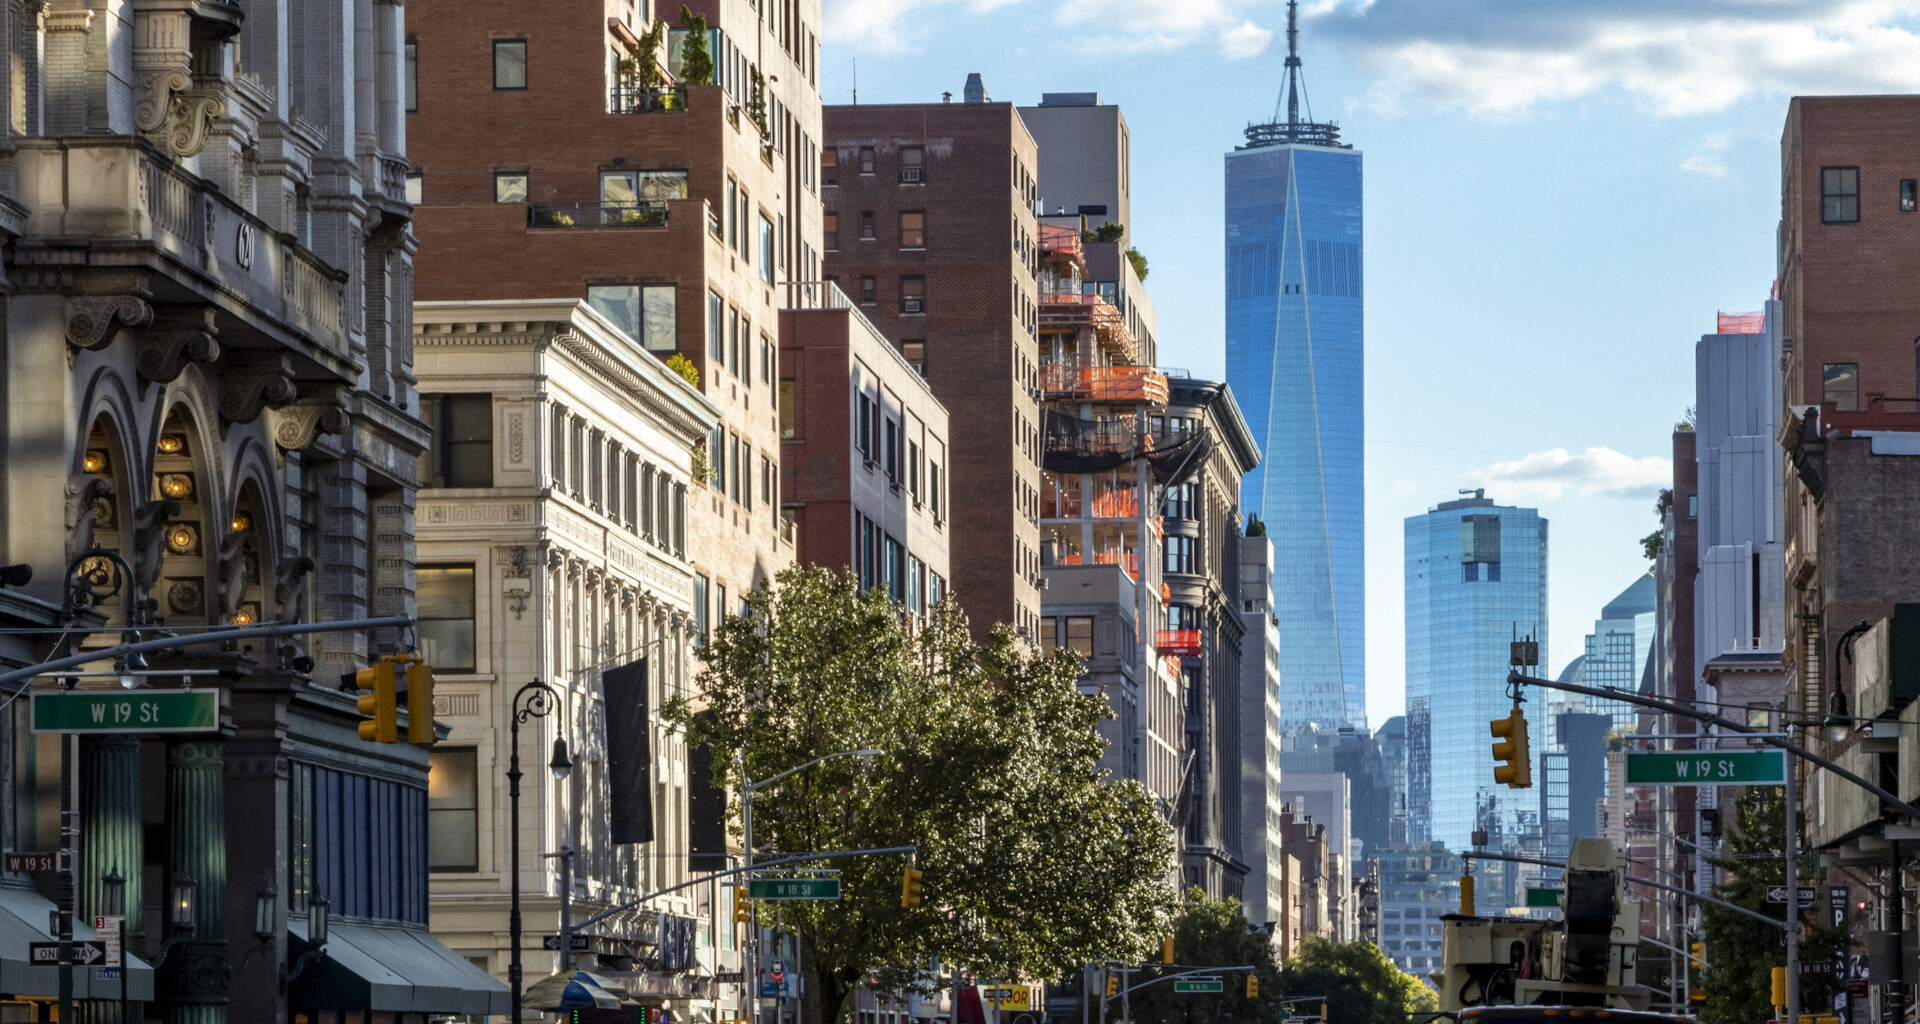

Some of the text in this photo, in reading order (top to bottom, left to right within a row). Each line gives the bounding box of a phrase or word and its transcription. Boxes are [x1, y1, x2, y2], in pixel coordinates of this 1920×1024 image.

[238, 223, 255, 270] 620
[91, 702, 159, 723] W 19 St
[1675, 760, 1735, 778] W 19 St
[10, 857, 52, 871] W 19 St
[777, 884, 812, 895] W 18 St
[97, 918, 104, 928] 3
[72, 949, 95, 959] WAY
[1804, 965, 1811, 973] W
[1812, 965, 1820, 973] 18
